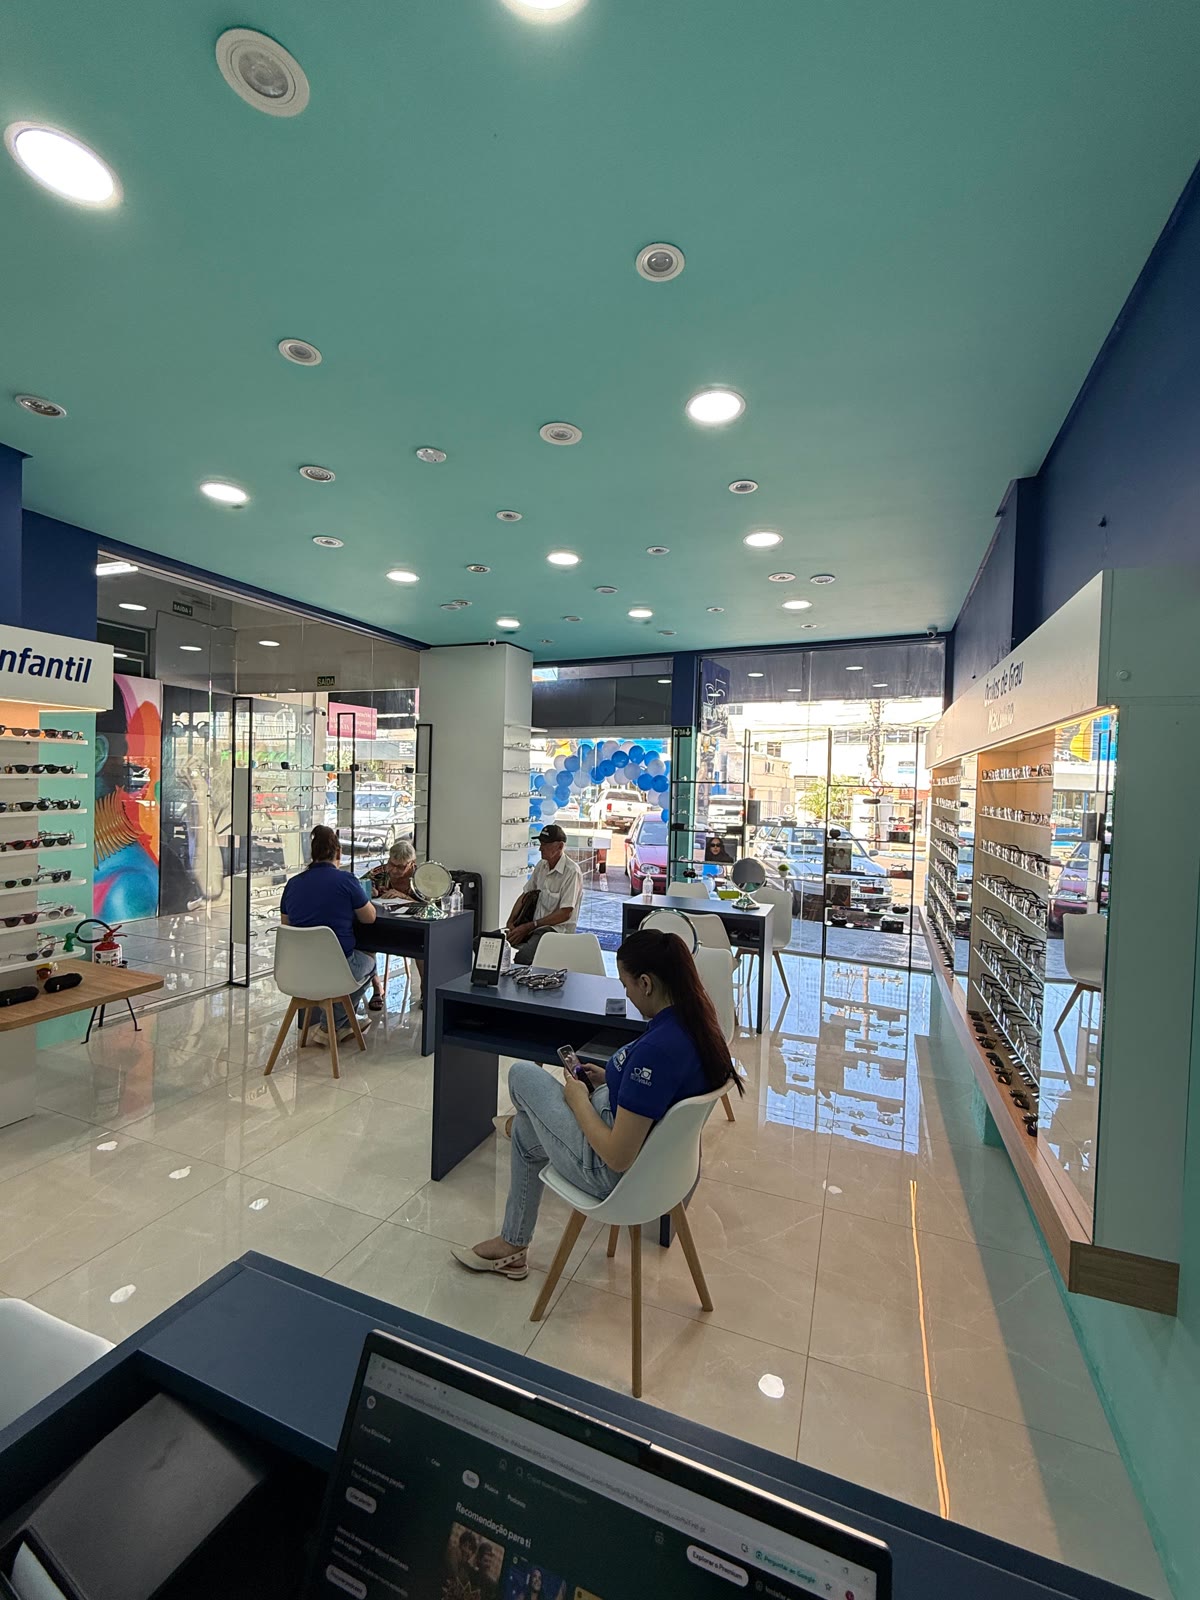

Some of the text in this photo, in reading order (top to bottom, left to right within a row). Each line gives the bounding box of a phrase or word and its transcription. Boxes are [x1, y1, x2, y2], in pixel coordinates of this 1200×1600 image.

[318, 677, 335, 686] SAÍDA
[456, 1502, 532, 1549] Recomendação para ti
[692, 1551, 714, 1567] Explorar
[719, 1564, 742, 1581] Premium
[797, 1570, 816, 1584] Google
